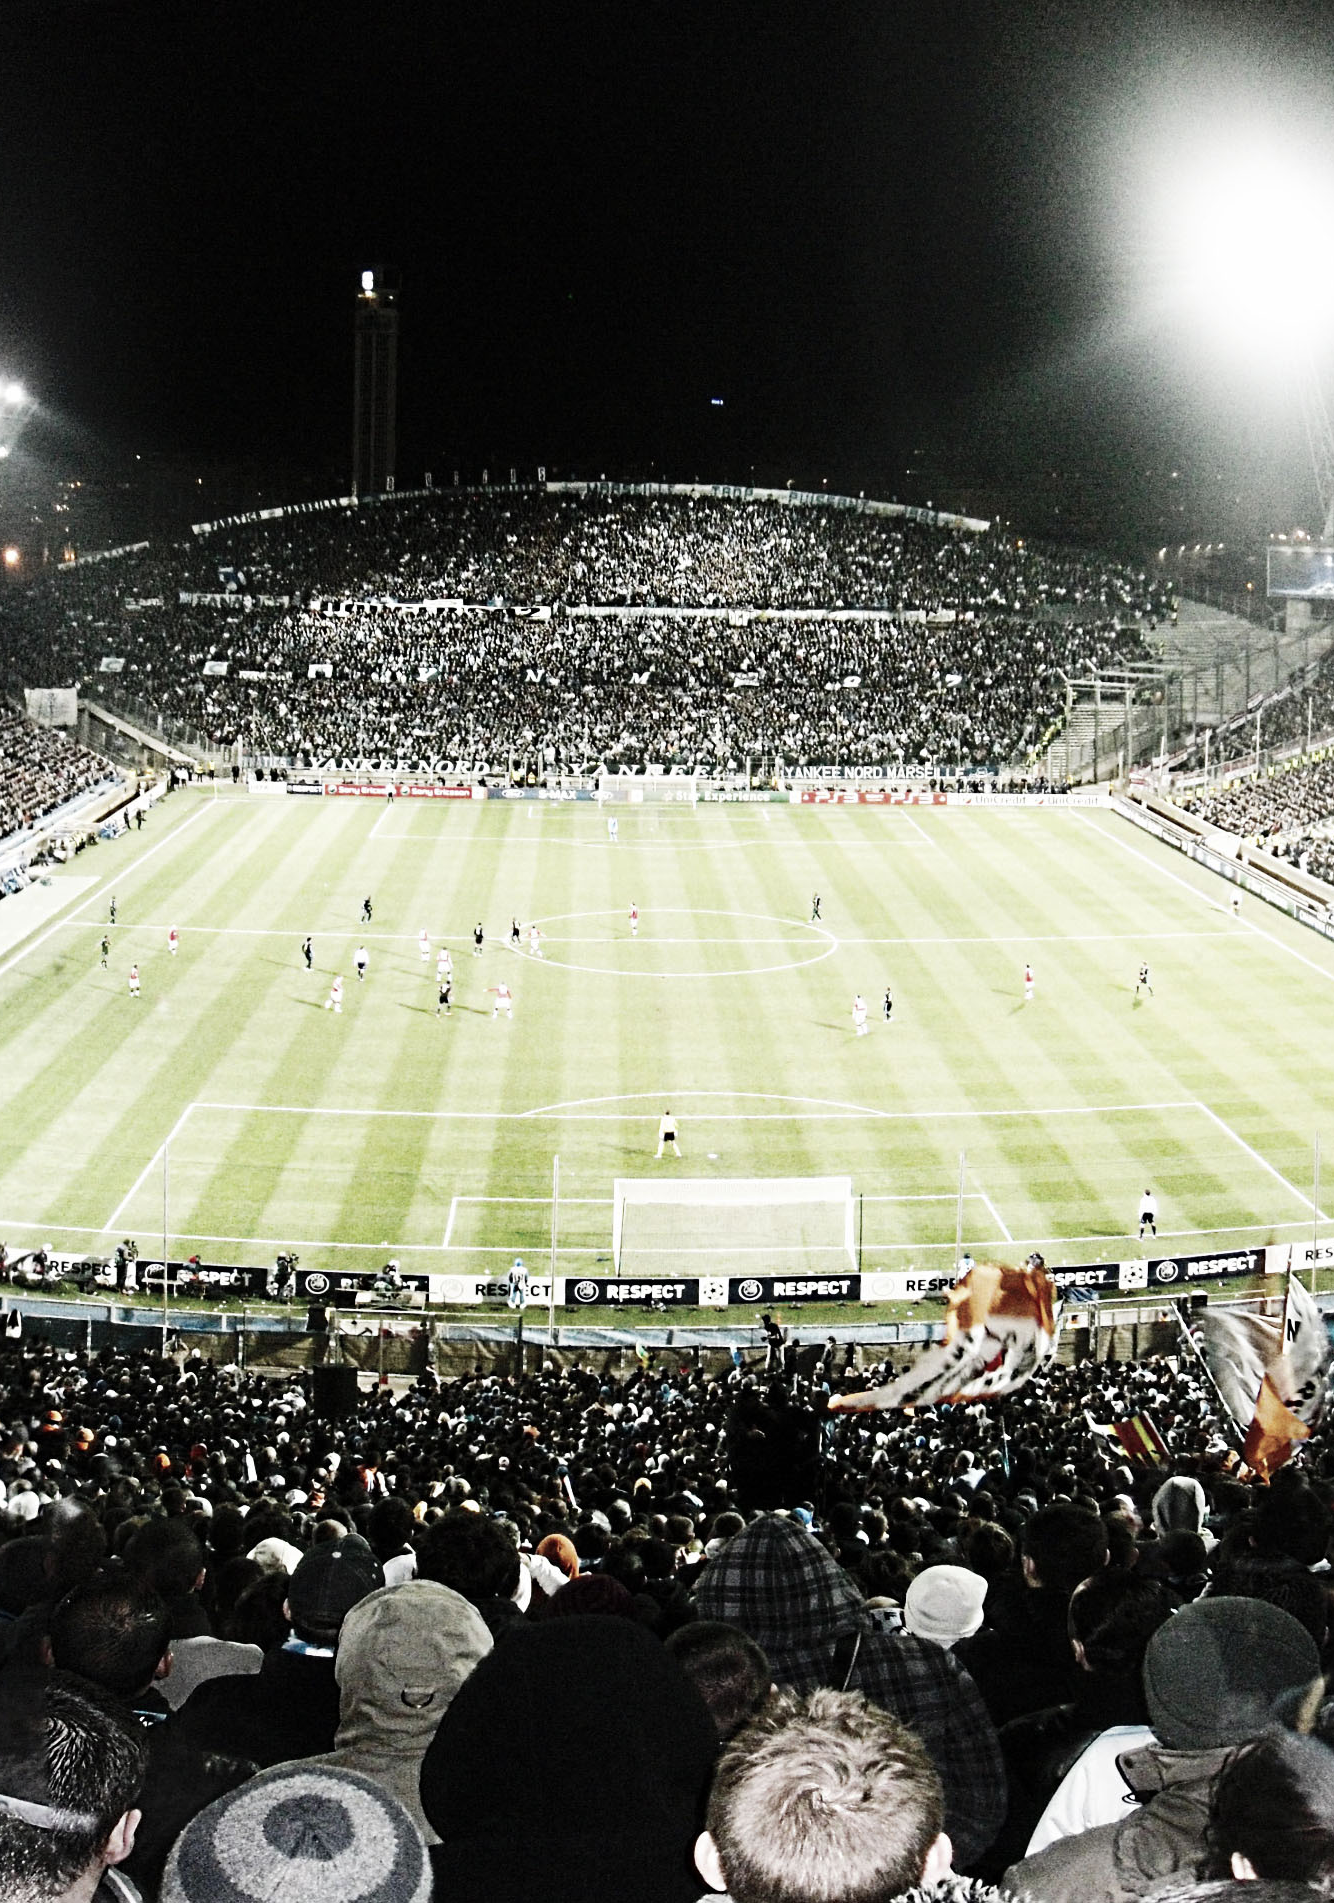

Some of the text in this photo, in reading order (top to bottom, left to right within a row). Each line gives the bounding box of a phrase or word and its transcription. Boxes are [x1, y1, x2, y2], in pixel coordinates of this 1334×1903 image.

[309, 758, 490, 774] YANKEE NORD
[784, 766, 965, 779] YANKEE NORD MARSEILLE
[704, 790, 770, 802] Experience
[975, 795, 1026, 805] UniCredit
[50, 1260, 116, 1276] RESPEC
[1187, 1255, 1258, 1277] RESPECT
[606, 1284, 686, 1299] RESPECT
[773, 1280, 851, 1296] RESPECT
